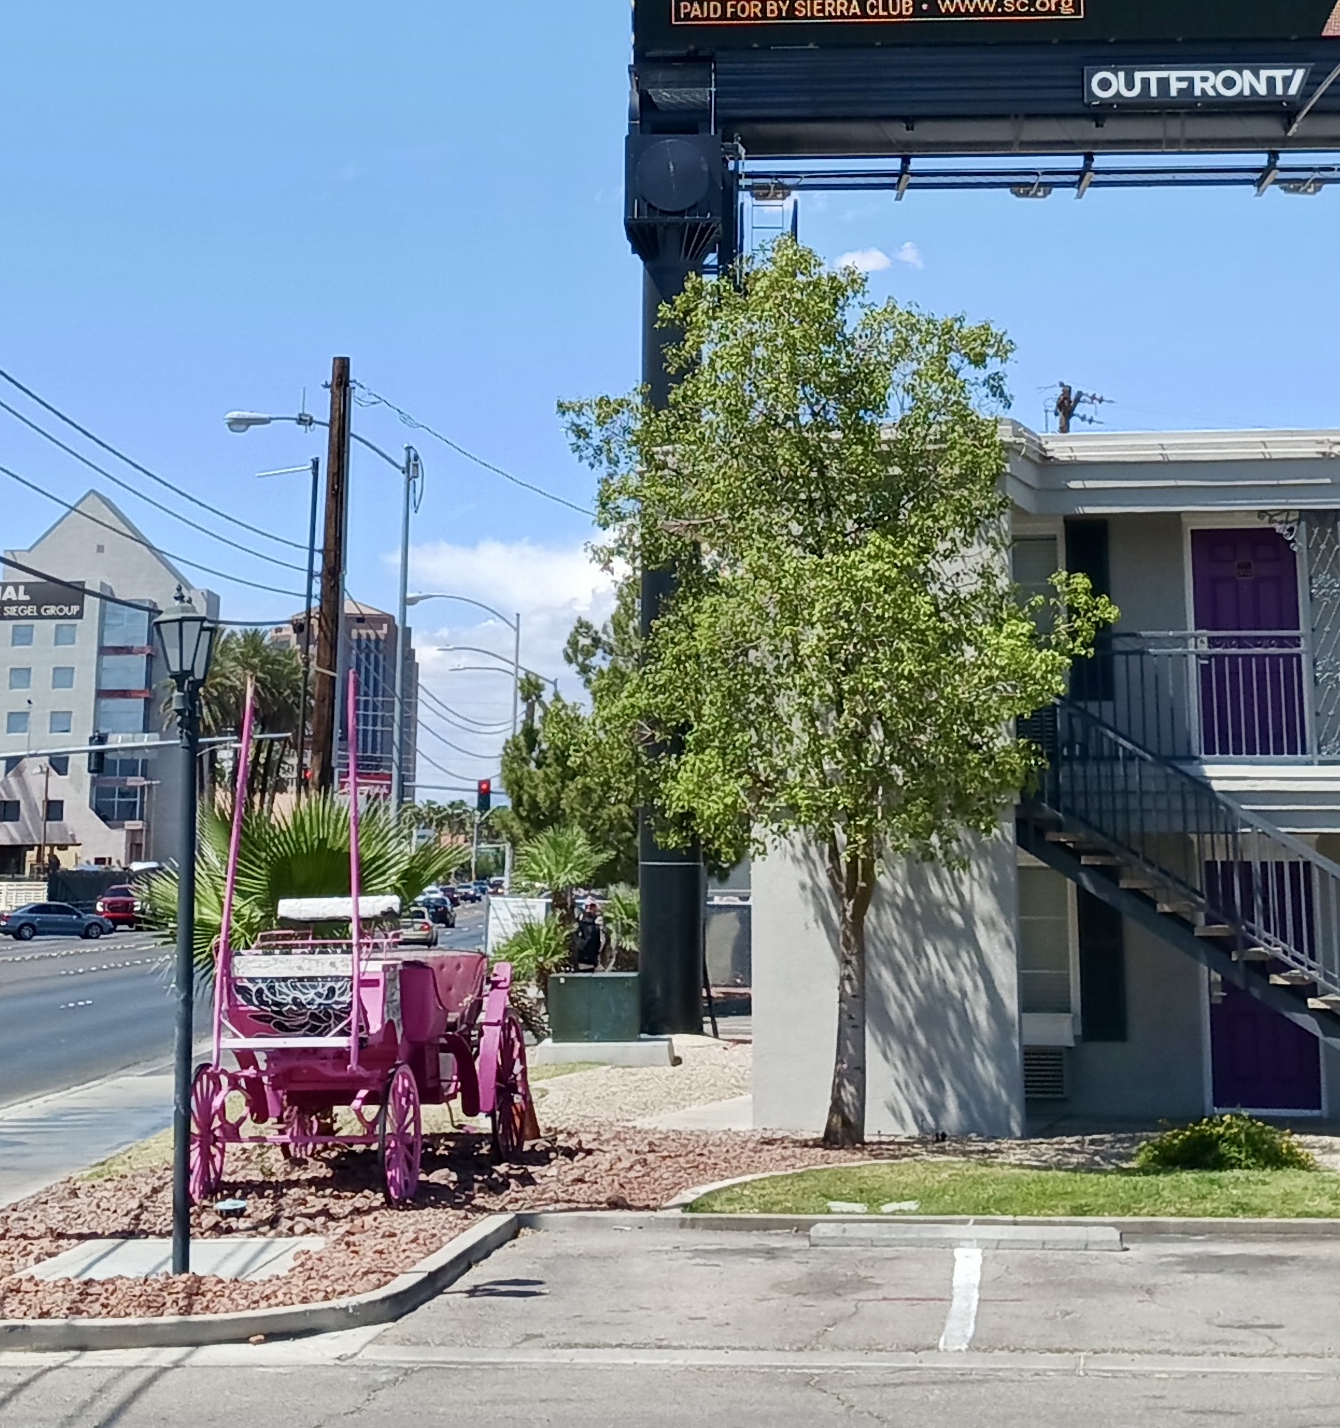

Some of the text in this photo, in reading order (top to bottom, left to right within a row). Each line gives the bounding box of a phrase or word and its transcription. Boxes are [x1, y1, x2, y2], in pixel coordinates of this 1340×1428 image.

[680, 1, 721, 18] PAID
[726, 1, 762, 18] FOR
[767, 0, 789, 17] BY
[4, 605, 38, 617] SIEGEL
[40, 605, 80, 616] GROUP
